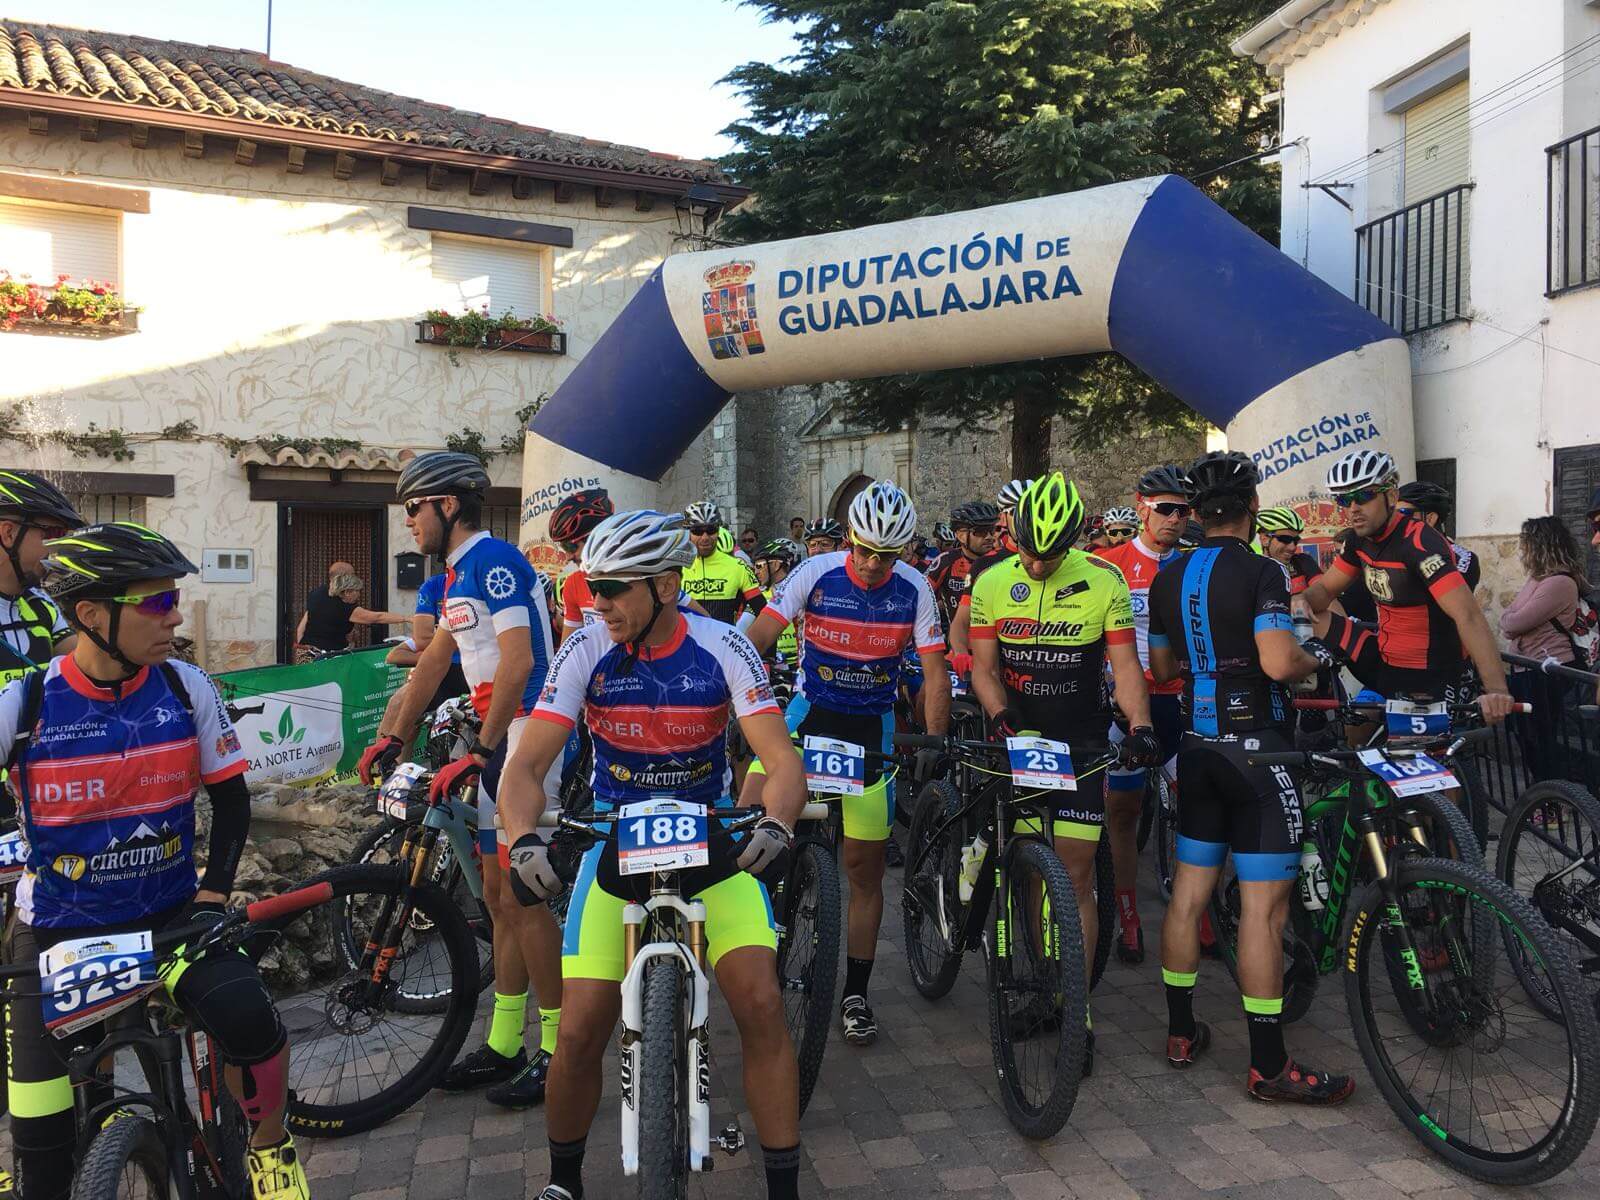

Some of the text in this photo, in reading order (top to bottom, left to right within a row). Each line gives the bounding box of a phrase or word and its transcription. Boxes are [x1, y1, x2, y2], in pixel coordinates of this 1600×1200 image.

[778, 232, 1071, 299] DIPUTACIÓN DE
[778, 265, 1082, 336] GUADALAJARA
[1252, 411, 1371, 464] PUTACIÓN DE
[1256, 424, 1380, 485] UADALAJARA
[524, 477, 600, 507] PUTACIÓN DE
[807, 622, 896, 648] LIDER Torija
[1001, 620, 1083, 637] Harobike
[1188, 583, 1209, 672] SERAL
[1024, 681, 1078, 696] SERVICE
[664, 722, 705, 736] Torija
[1411, 717, 1427, 734] 5
[266, 748, 302, 768] NORTE
[306, 741, 341, 758] Aventura
[811, 753, 855, 777] 161
[1025, 750, 1059, 771] 25
[35, 770, 186, 803] IDER Brihuega
[1058, 808, 1104, 822] rotulos
[630, 816, 697, 846] 188
[91, 870, 137, 885] Diputación
[1348, 911, 1368, 973] MAXXIS
[54, 957, 140, 1012] 529
[622, 1048, 635, 1111] FOX
[290, 1115, 345, 1129] MAXXI
